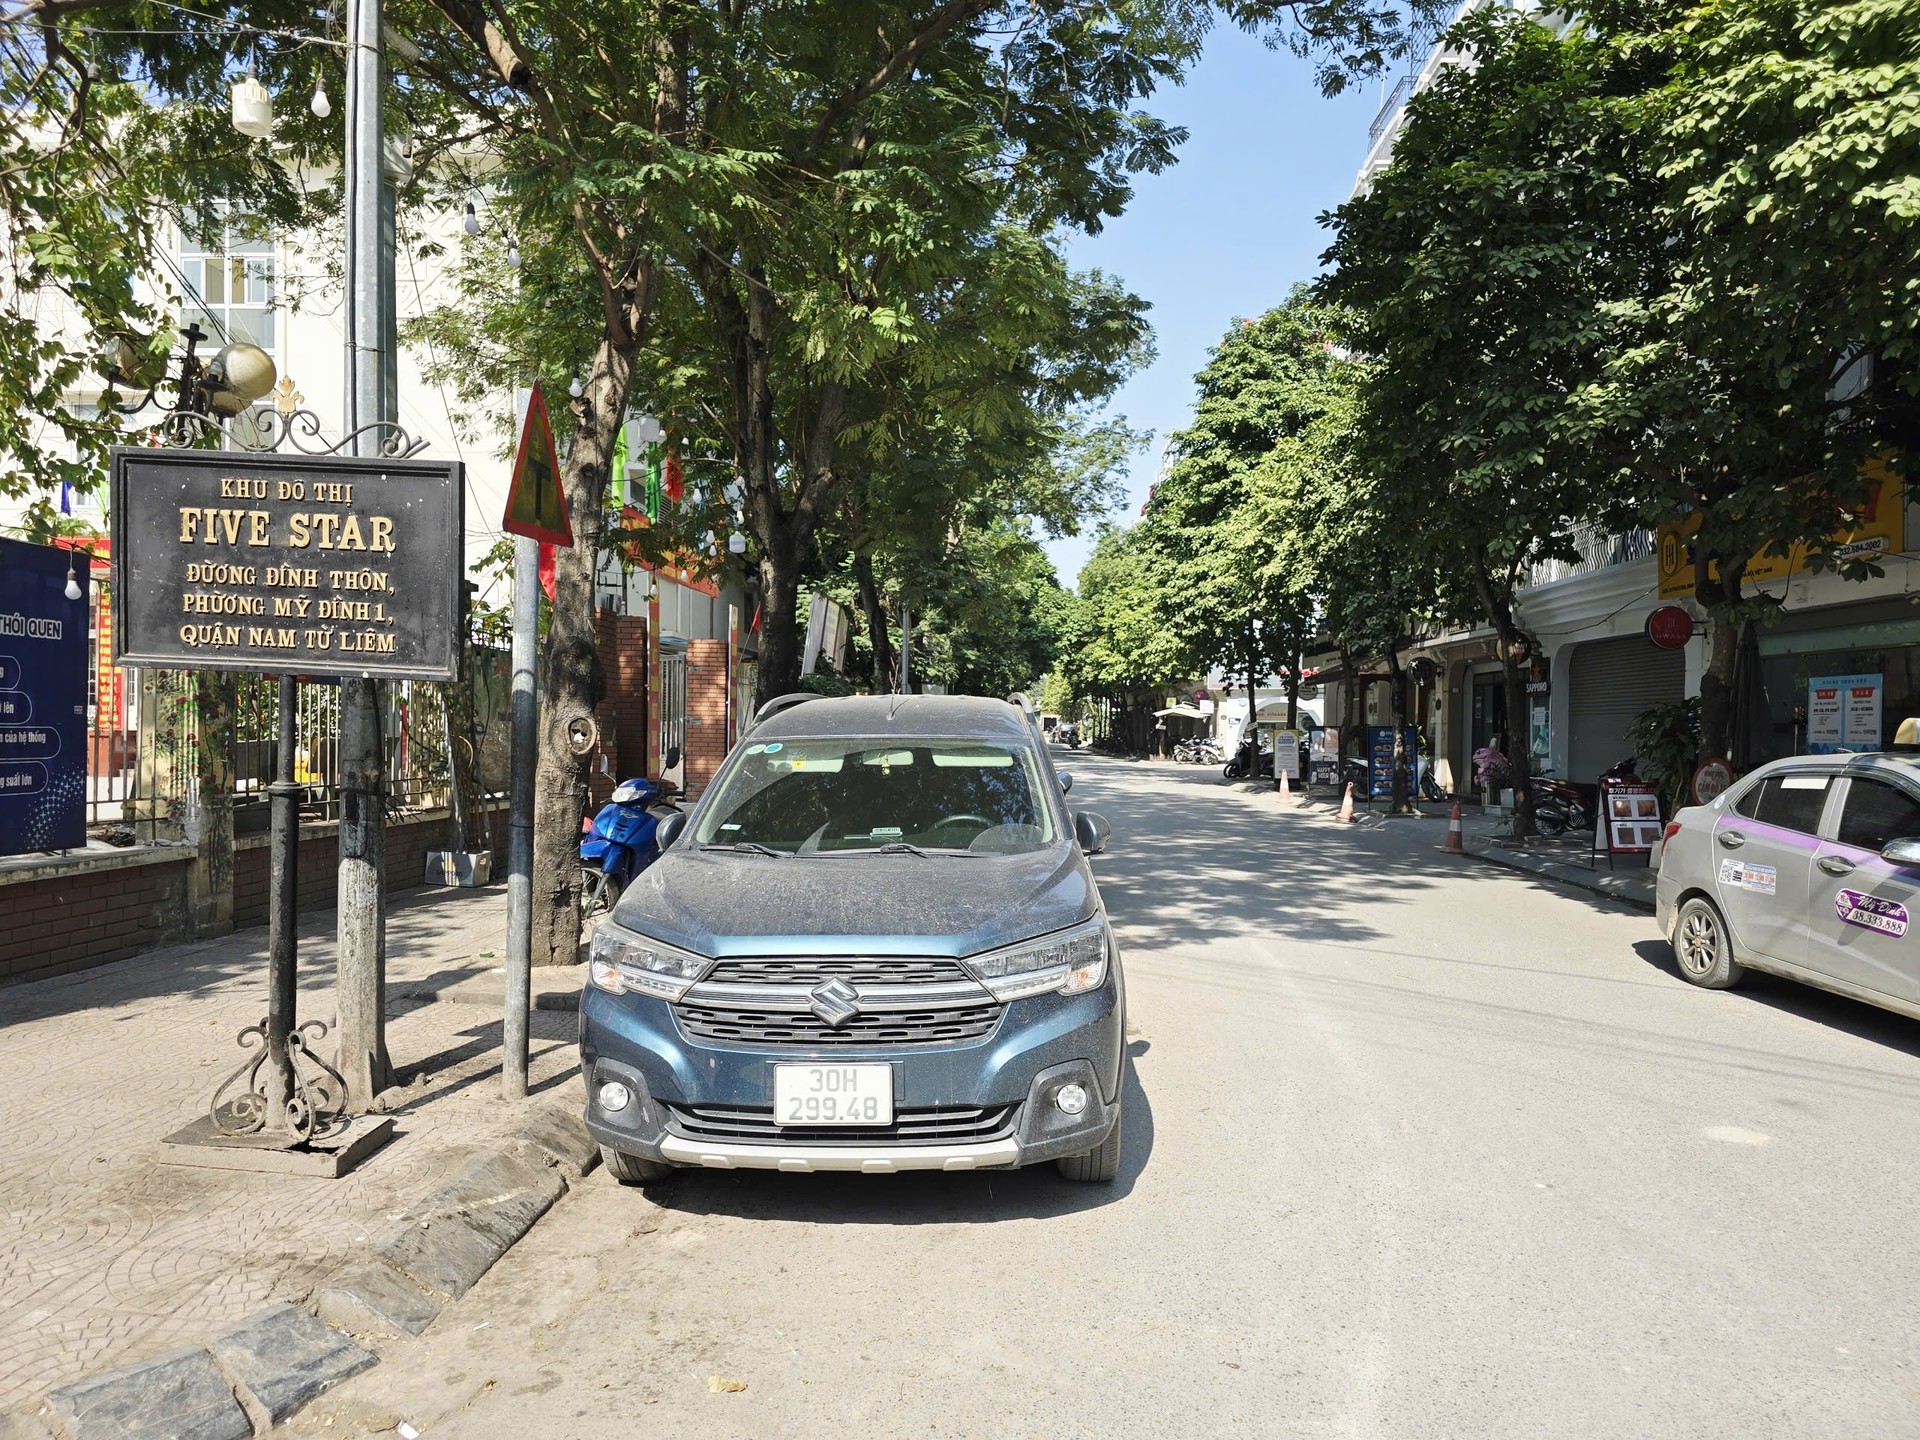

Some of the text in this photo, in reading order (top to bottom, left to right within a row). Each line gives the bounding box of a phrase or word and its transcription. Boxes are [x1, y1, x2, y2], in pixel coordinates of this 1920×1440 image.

[221, 478, 353, 507] KHU ĐÔ THỊ
[179, 507, 396, 552] FIVE STAR
[266, 562, 318, 588] ĐÌNH
[330, 567, 395, 595] THÔN,
[274, 594, 311, 618] MỸ
[318, 594, 370, 621] ĐÌNH
[375, 603, 394, 625] 1,
[27, 617, 62, 640] QUEN
[180, 622, 396, 653] QUẬN NAM TỪ LIÊM
[1526, 682, 1547, 693] SAPPORO
[1852, 910, 1903, 933] 38.333.888
[809, 1068, 857, 1092] 30H
[788, 1096, 878, 1120] 299.48
